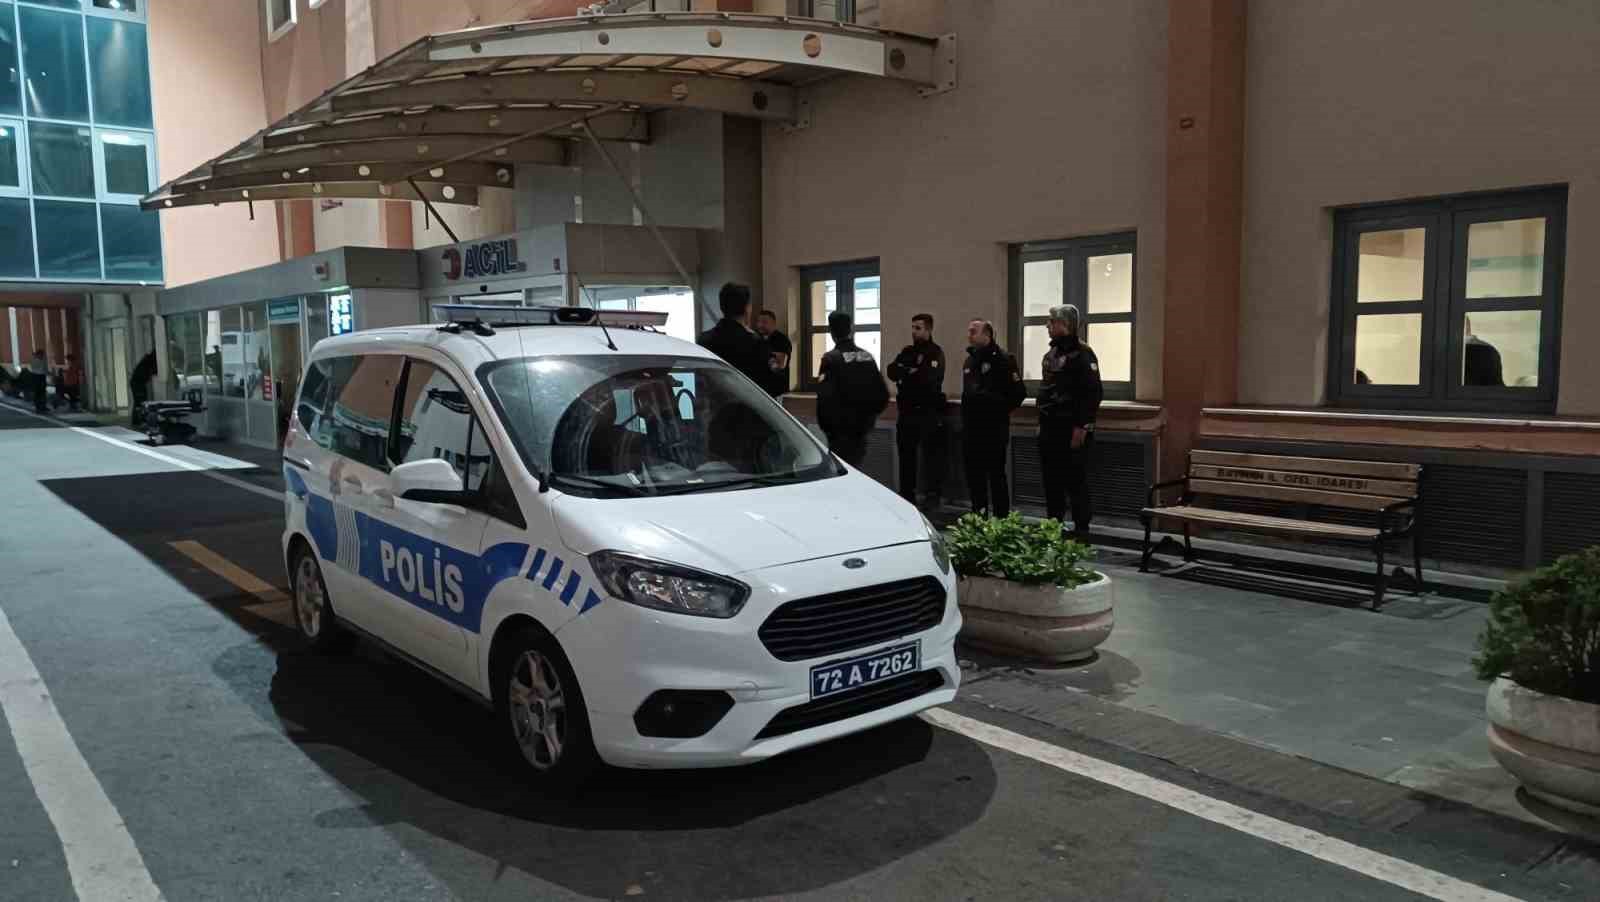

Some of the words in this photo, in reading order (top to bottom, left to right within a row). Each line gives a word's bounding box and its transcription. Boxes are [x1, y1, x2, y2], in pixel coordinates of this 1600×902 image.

[380, 539, 465, 613] POLİS
[818, 669, 842, 692] 72
[848, 664, 863, 685] A
[868, 651, 913, 679] 7262
